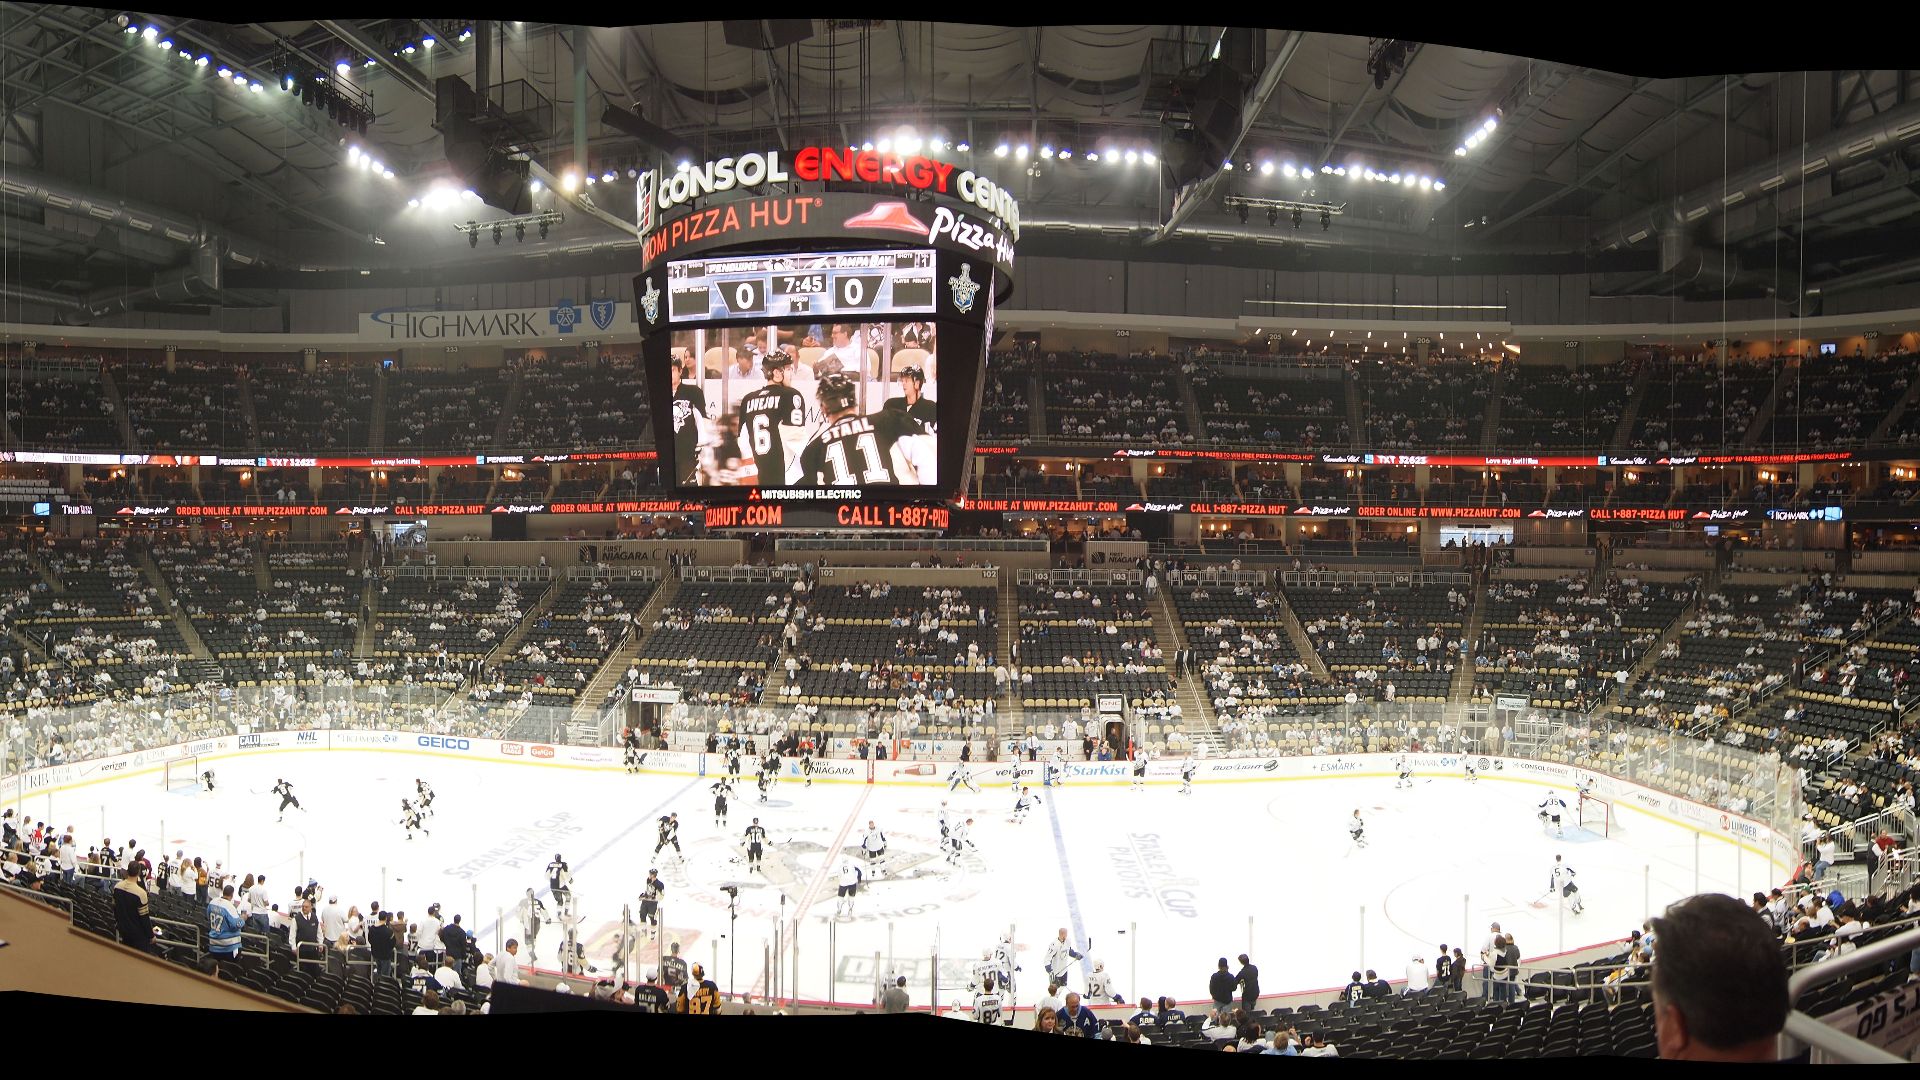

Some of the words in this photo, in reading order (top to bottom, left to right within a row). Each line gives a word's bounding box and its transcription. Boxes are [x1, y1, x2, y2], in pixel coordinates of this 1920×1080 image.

[658, 151, 789, 209] CONSOL
[794, 146, 955, 192] ENERGY
[672, 206, 740, 248] PIZZA
[929, 205, 995, 250] Pizza
[836, 255, 869, 267] TAMPA
[870, 254, 892, 267] BAY
[783, 276, 823, 293] 7:45
[736, 283, 754, 309] 0
[844, 278, 863, 306] 0
[390, 312, 541, 339] HIGHMARK
[1565, 340, 1579, 348] 207
[746, 396, 780, 413] LOVEJOY
[752, 413, 770, 455] 6
[821, 417, 875, 444] STAAL
[270, 458, 288, 466] TXT
[825, 433, 890, 486] 11
[1378, 455, 1395, 464] TXT
[761, 490, 814, 500] MITSUBISHI
[816, 489, 862, 499] ELECTRIC
[176, 507, 201, 515] ORDER
[203, 507, 230, 515] ONLINE
[232, 507, 241, 515] AT
[395, 507, 414, 515] CALL
[416, 505, 465, 514] 1-887-PIZZA
[508, 504, 528, 514] Pizza
[529, 504, 544, 513] Hut
[551, 504, 575, 513] ORDER
[578, 503, 604, 513] ONLINE
[606, 503, 615, 512] AT
[978, 501, 1008, 510] ONLINE
[1010, 501, 1020, 510] AT
[1144, 503, 1167, 512] Pizza
[1168, 503, 1184, 512] Hut
[1190, 504, 1211, 513] CALL
[1213, 504, 1266, 514] 1-887-PIZZA
[1312, 507, 1333, 515] Pizza
[1333, 507, 1350, 515] Hut
[838, 506, 883, 526] CALL
[1358, 507, 1385, 516] ORDER
[1387, 507, 1416, 516] ONLINE
[1418, 508, 1429, 516] AT
[1546, 509, 1567, 518] Pizza
[1568, 509, 1584, 517] Hut
[1590, 509, 1611, 519] CALL
[1613, 509, 1666, 519] 1-887-PIZZA
[602, 552, 648, 560] NIAGARA
[772, 570, 784, 578] 101
[240, 735, 260, 745] CALU
[297, 731, 318, 742] NHL
[190, 742, 213, 753] LUMBER
[417, 735, 470, 751] GEICO
[101, 760, 127, 772] verizon
[811, 767, 855, 775] NIAGARA
[1072, 765, 1128, 776] StarKist
[1320, 762, 1356, 772] ESMARK
[1521, 763, 1546, 771] CONSOL
[1546, 767, 1569, 776] ENERGY
[1548, 798, 1559, 806] 35
[1637, 793, 1661, 807] verizon
[442, 834, 528, 880] STANLEY
[534, 811, 573, 830] CUP
[1554, 867, 1561, 877] 5
[209, 877, 220, 888] 58
[1160, 889, 1198, 918] CUP
[210, 912, 223, 932] 87
[1351, 989, 1364, 1001] 87
[1083, 1018, 1091, 1026] A
